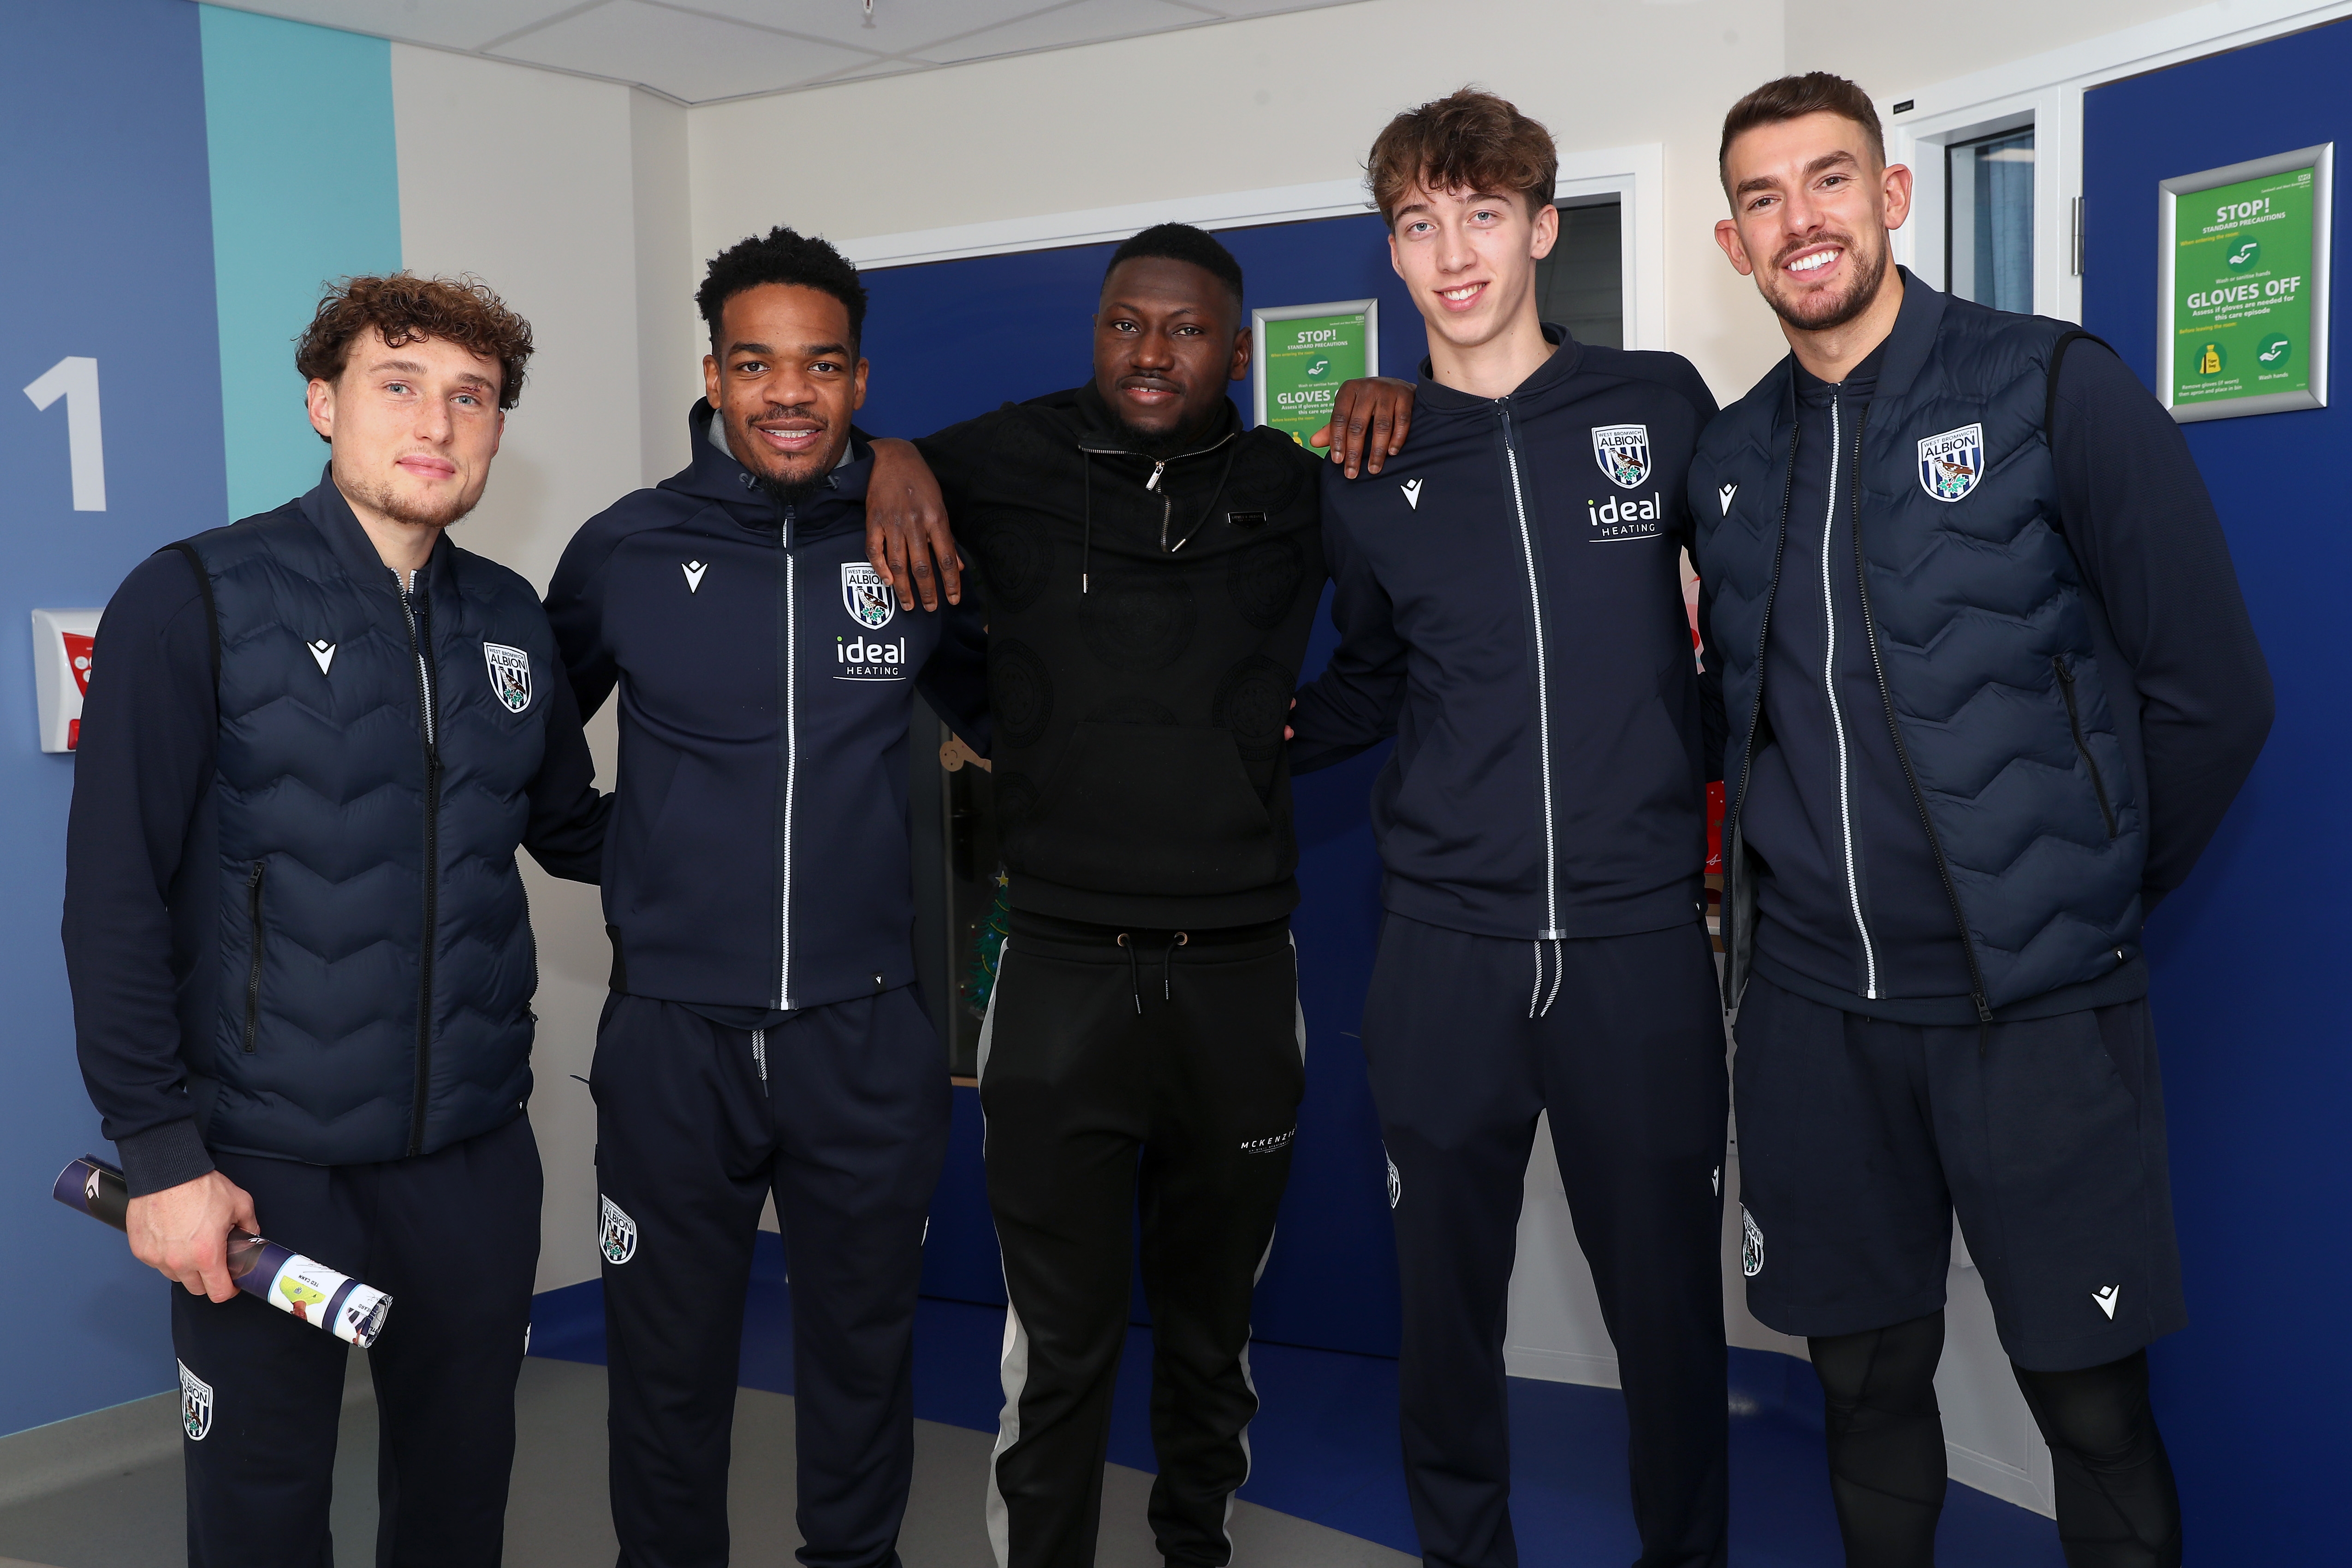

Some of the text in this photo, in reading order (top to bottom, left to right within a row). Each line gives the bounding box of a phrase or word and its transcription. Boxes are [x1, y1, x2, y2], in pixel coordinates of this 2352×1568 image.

[2216, 197, 2270, 223] STOP!
[2203, 212, 2286, 234] STANDARD PRECAUTIONS
[2187, 276, 2301, 309] GLOVES OFF
[2192, 308, 2214, 317] Assess
[2221, 303, 2244, 313] gloves
[2257, 297, 2282, 307] needed
[2244, 307, 2270, 318] episode
[1297, 329, 1336, 343] STOP!
[1277, 390, 1331, 404] GLOVES
[22, 355, 107, 512] 1
[1600, 435, 1643, 448] ALBION
[1924, 429, 1975, 447] WEST BROMWICH
[1924, 434, 1976, 459] ALBION
[1588, 491, 1661, 526] ideal
[1602, 523, 1656, 537] HEATING
[837, 636, 905, 665] ideal
[491, 653, 526, 671] ALBION
[847, 666, 898, 676] HEATING
[604, 1207, 632, 1233] ALBION
[298, 1274, 311, 1283] CANN
[181, 1374, 207, 1404] ALBION
